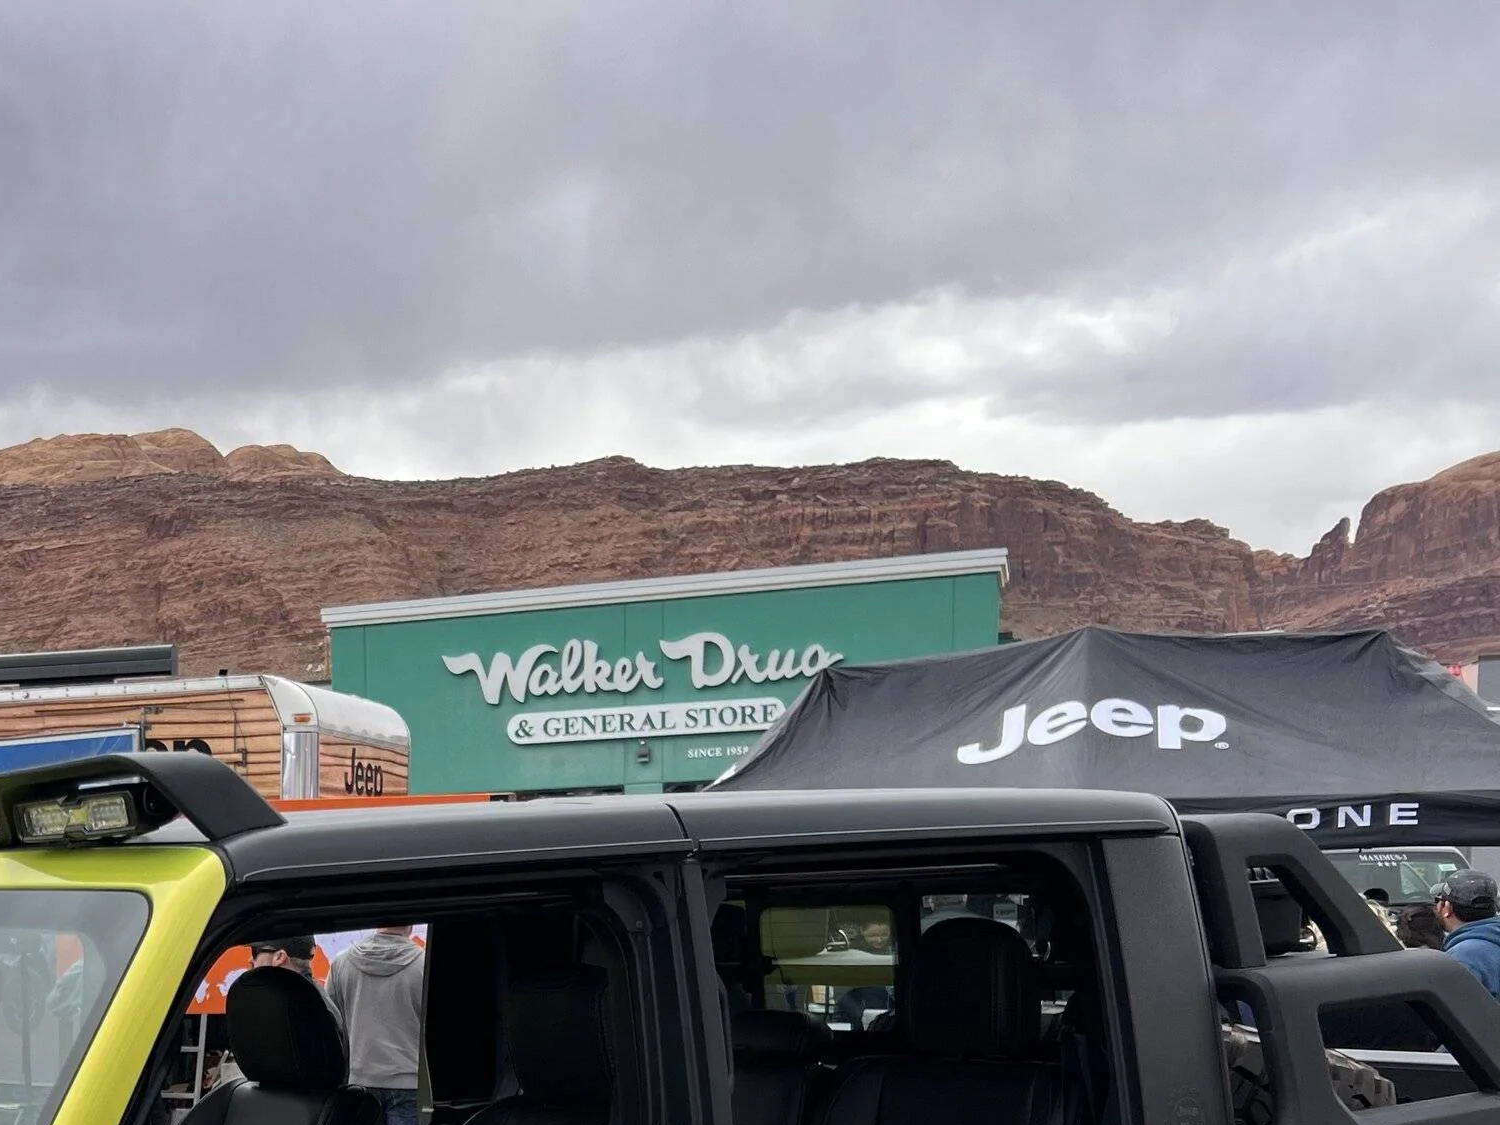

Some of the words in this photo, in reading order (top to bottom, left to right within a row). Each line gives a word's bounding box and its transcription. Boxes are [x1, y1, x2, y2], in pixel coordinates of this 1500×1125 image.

[442, 638, 663, 705] Walker
[514, 719, 535, 739] &
[544, 710, 677, 738] GENERAL
[685, 704, 778, 729] STORE
[956, 697, 1227, 765] Jeep
[345, 747, 384, 797] Jeep
[687, 747, 723, 759] SINCE
